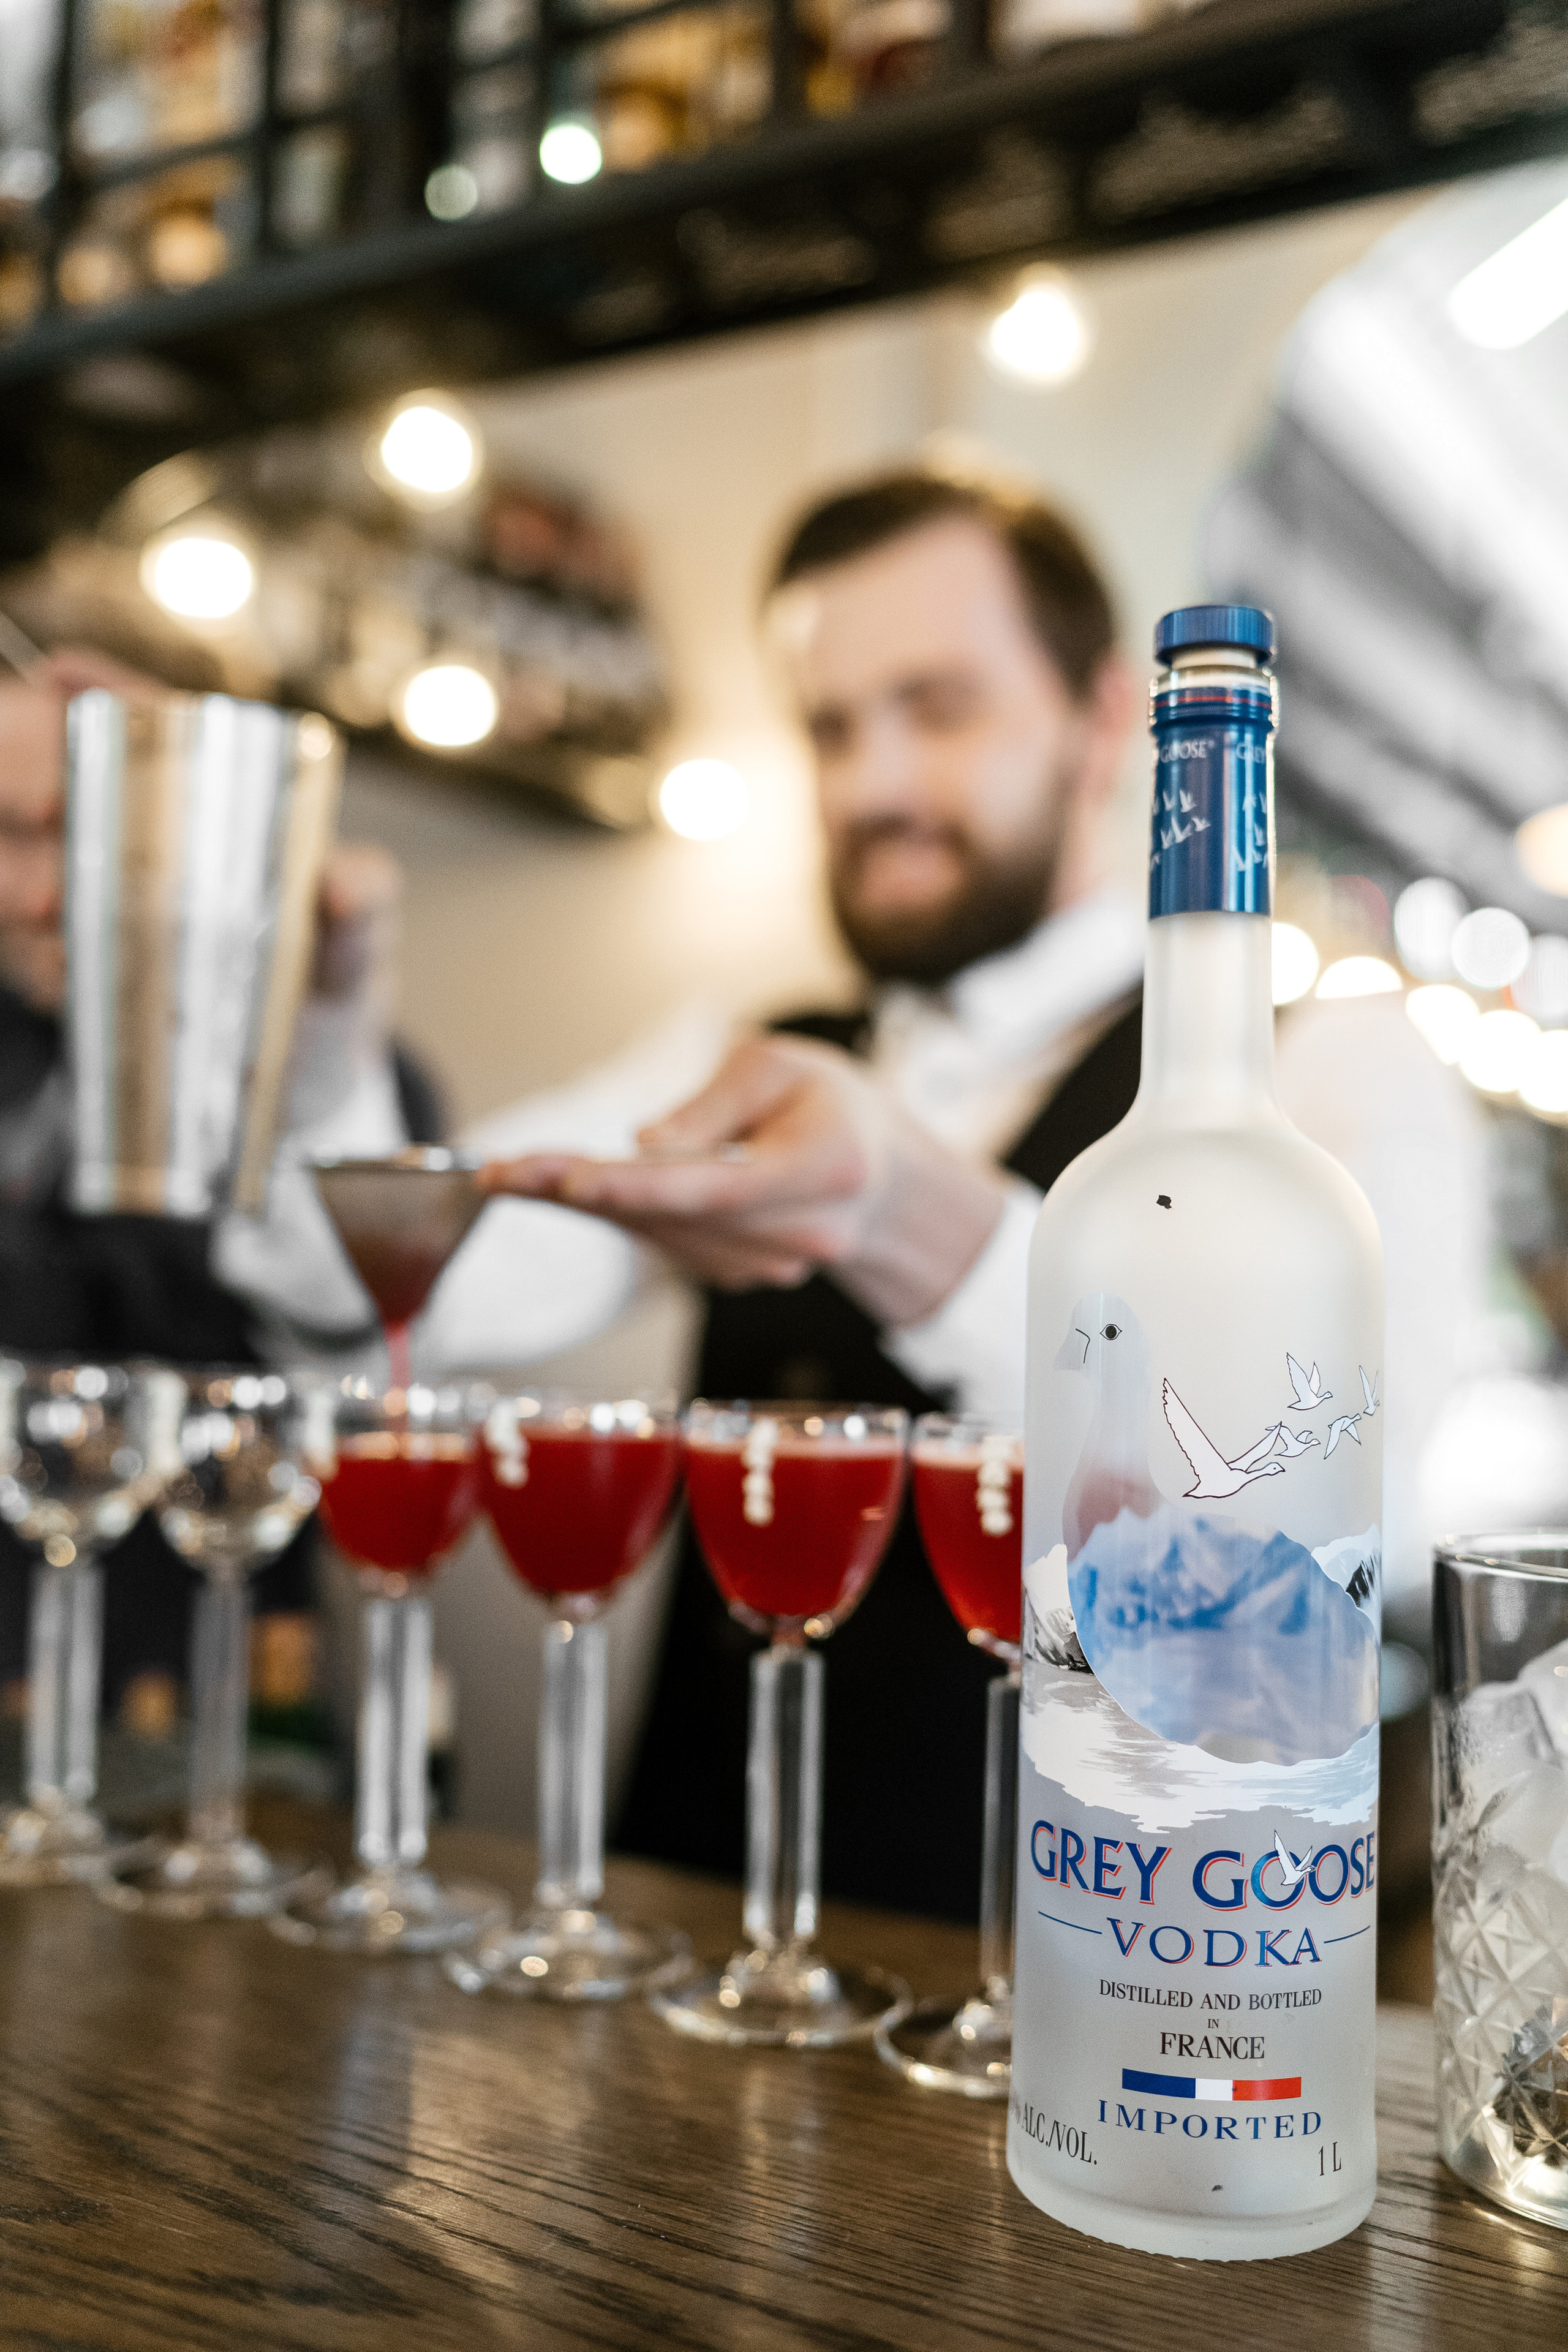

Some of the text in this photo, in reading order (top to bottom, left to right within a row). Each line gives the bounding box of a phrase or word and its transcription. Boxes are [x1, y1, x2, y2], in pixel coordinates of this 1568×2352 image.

[1031, 1820, 1376, 1912] GREY GOOSE
[1106, 1917, 1323, 1967] VODKA
[1099, 1979, 1322, 2010] DISTILLED AND BOTTLED
[1207, 2018, 1219, 2029] IN
[1159, 2032, 1265, 2060] FRANCE
[1098, 2099, 1321, 2140] IMPORTED
